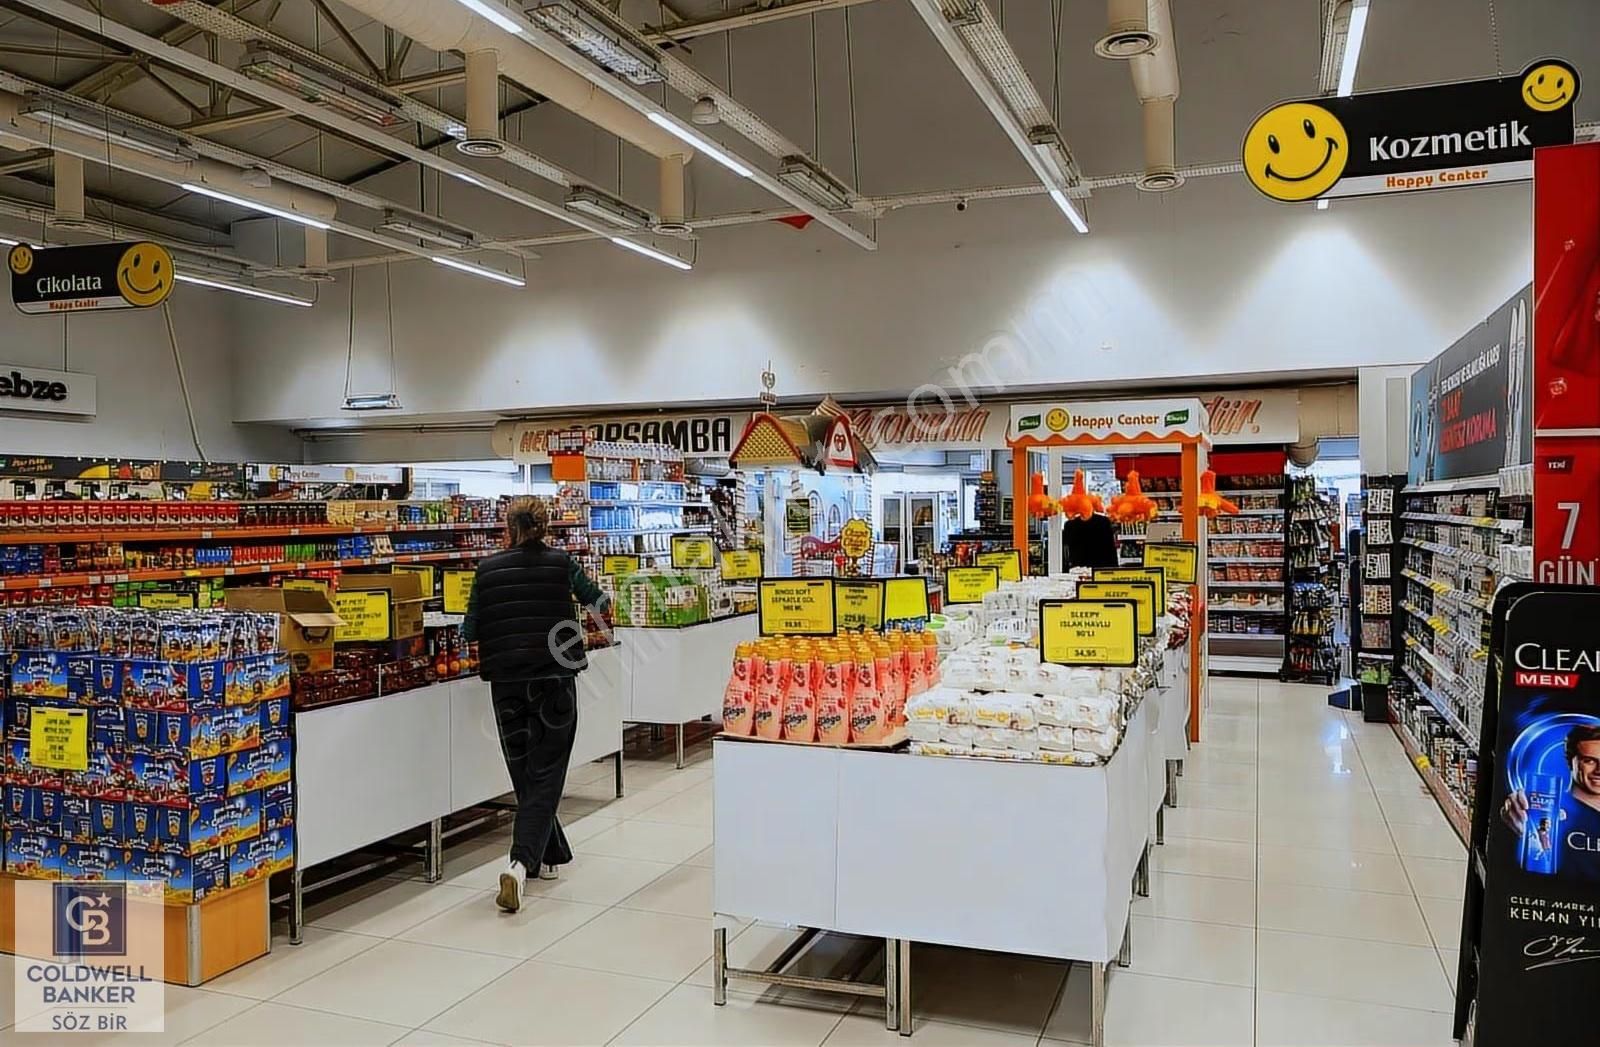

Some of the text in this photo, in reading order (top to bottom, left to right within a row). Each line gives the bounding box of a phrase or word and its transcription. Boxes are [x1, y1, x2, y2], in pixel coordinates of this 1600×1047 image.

[1370, 120, 1532, 161] Kozmetik
[1386, 168, 1489, 188] Happy Center
[36, 274, 103, 298] Çikolata
[1072, 414, 1114, 429] Happy
[1117, 413, 1160, 426] Center
[1557, 502, 1580, 550] 7
[1519, 674, 1570, 687] MEN
[1510, 896, 1595, 912] CLEAR MARKA
[1510, 907, 1569, 925] KENAN
